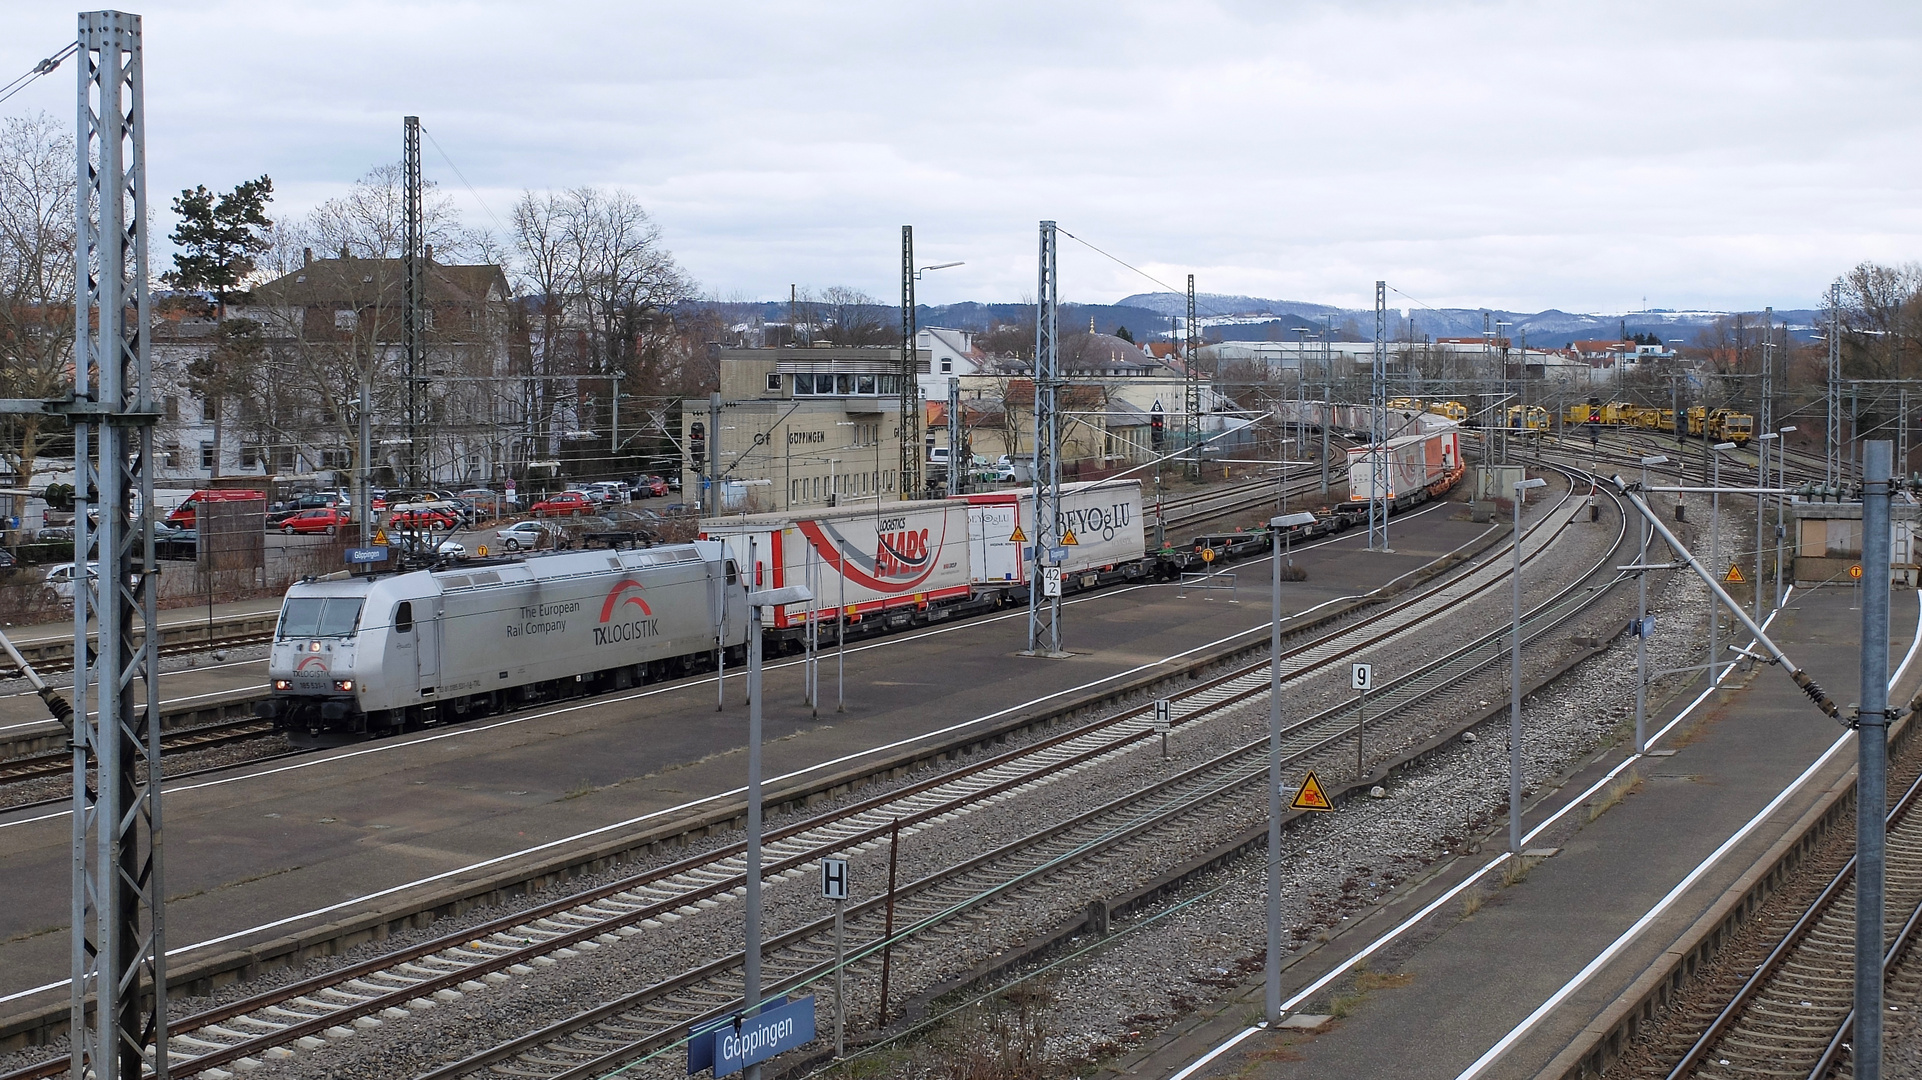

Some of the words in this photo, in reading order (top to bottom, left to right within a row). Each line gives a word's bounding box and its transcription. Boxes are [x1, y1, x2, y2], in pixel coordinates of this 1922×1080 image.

[789, 431, 825, 445] GÖPPINGEN
[879, 518, 906, 532] LOGISTICS
[354, 550, 380, 560] Göppingen
[873, 528, 929, 579] MARS
[1045, 568, 1060, 581] 42
[1048, 581, 1057, 594] 2
[520, 606, 537, 619] The
[539, 601, 580, 618] European
[506, 623, 523, 638] Rail
[525, 620, 567, 635] Company
[1357, 667, 1366, 686] 9
[1156, 702, 1168, 720] H
[825, 862, 844, 896] H
[723, 1017, 793, 1061] Göppingen
